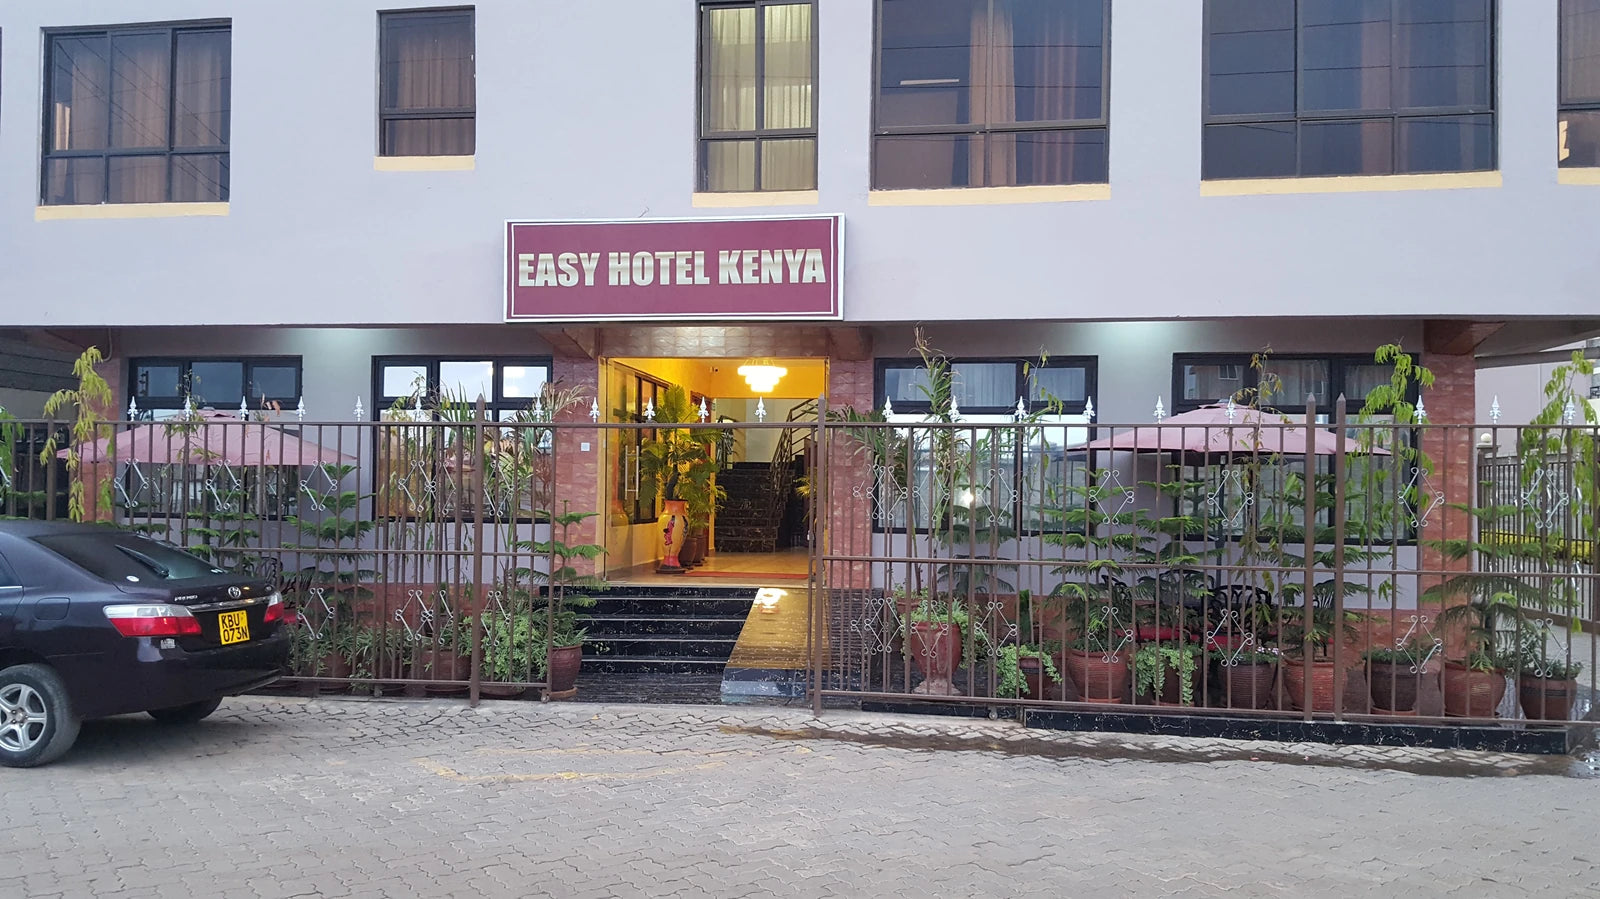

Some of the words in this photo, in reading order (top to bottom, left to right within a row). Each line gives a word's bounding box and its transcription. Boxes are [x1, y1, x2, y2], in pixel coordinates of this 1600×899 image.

[518, 252, 600, 287] EASY
[608, 250, 710, 286] HOTEL
[718, 248, 827, 285] KENYA
[221, 613, 240, 629] KBU
[223, 626, 248, 642] 073N
